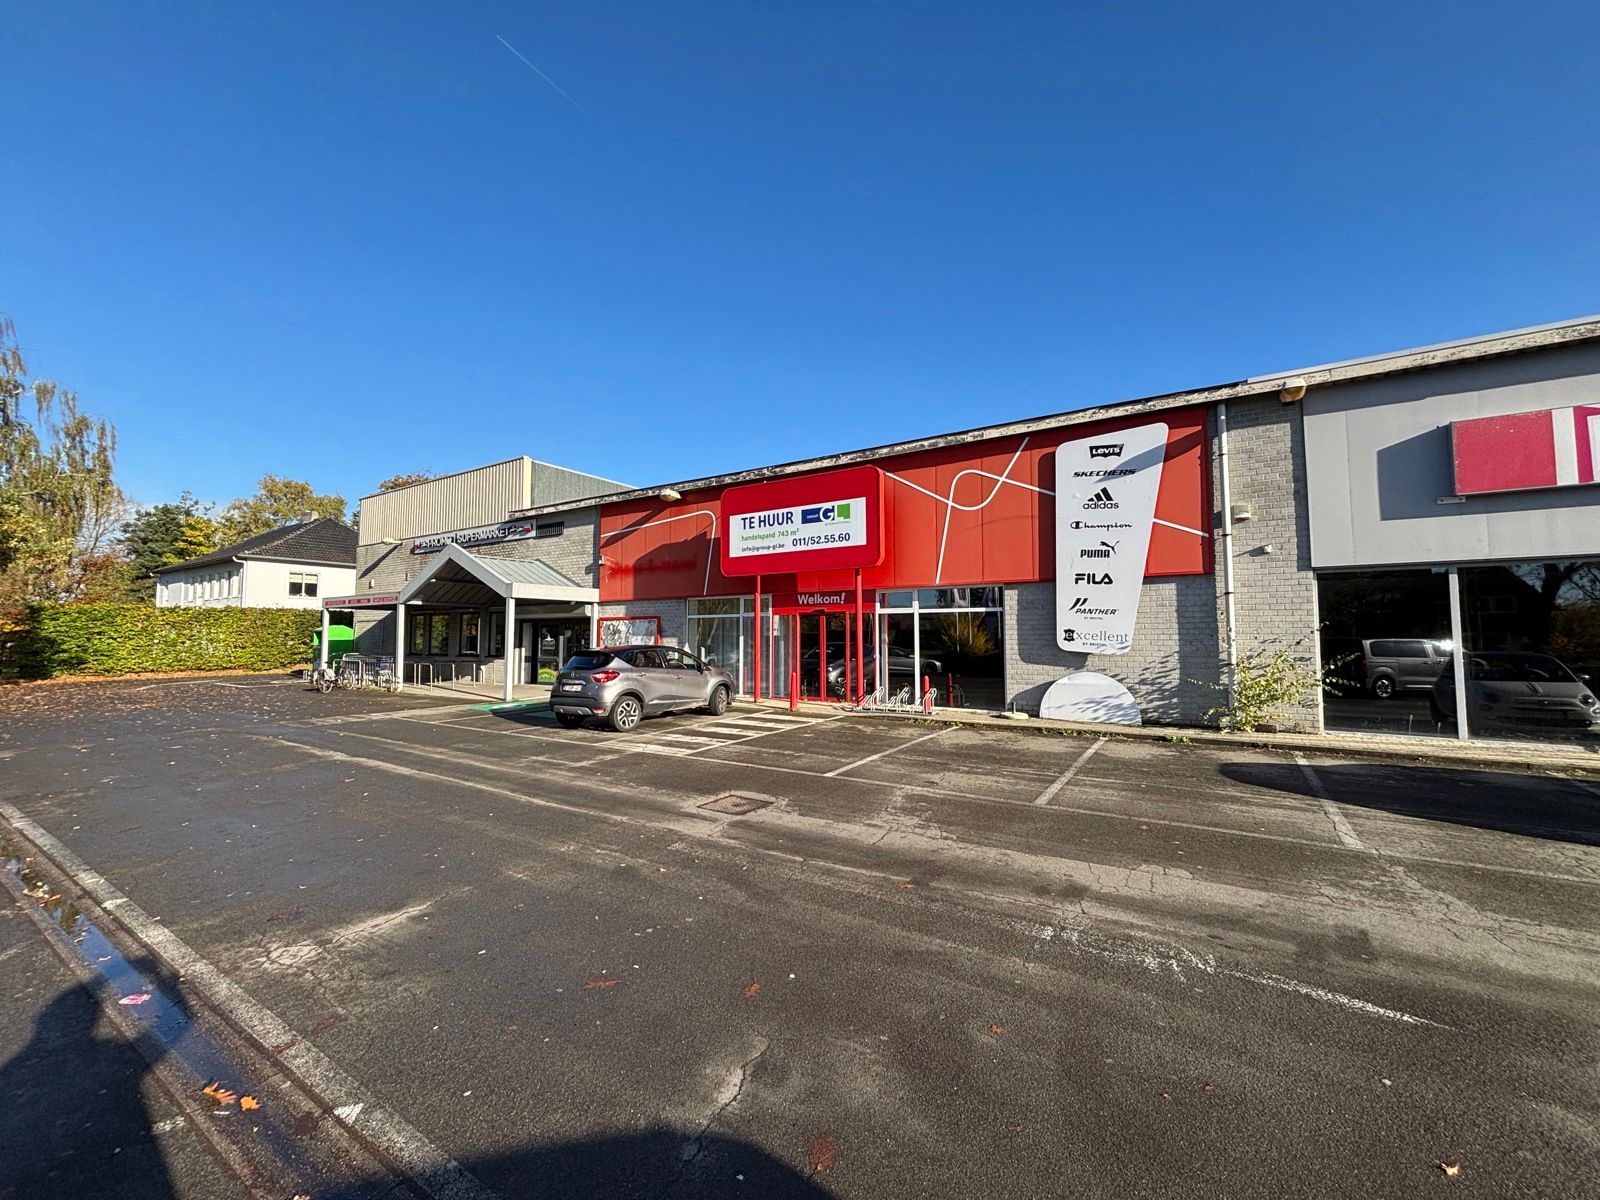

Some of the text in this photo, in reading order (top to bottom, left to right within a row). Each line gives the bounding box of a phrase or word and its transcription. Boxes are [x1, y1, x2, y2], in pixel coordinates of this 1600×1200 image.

[1073, 468, 1137, 478] SKECHERS
[1082, 501, 1119, 510] adidas
[741, 511, 794, 530] TE HUUR
[1070, 521, 1133, 531] Champion
[457, 529, 509, 543] SUPERMARKET
[741, 532, 775, 541] handelspand
[778, 529, 789, 537] 743
[792, 532, 851, 547] 011/52.55.60
[741, 543, 785, 552] info@group-gl.be
[1080, 549, 1111, 559] PUMA
[1074, 573, 1114, 585] FILA
[797, 592, 846, 605] Welkom!
[1064, 629, 1129, 643] excellent
